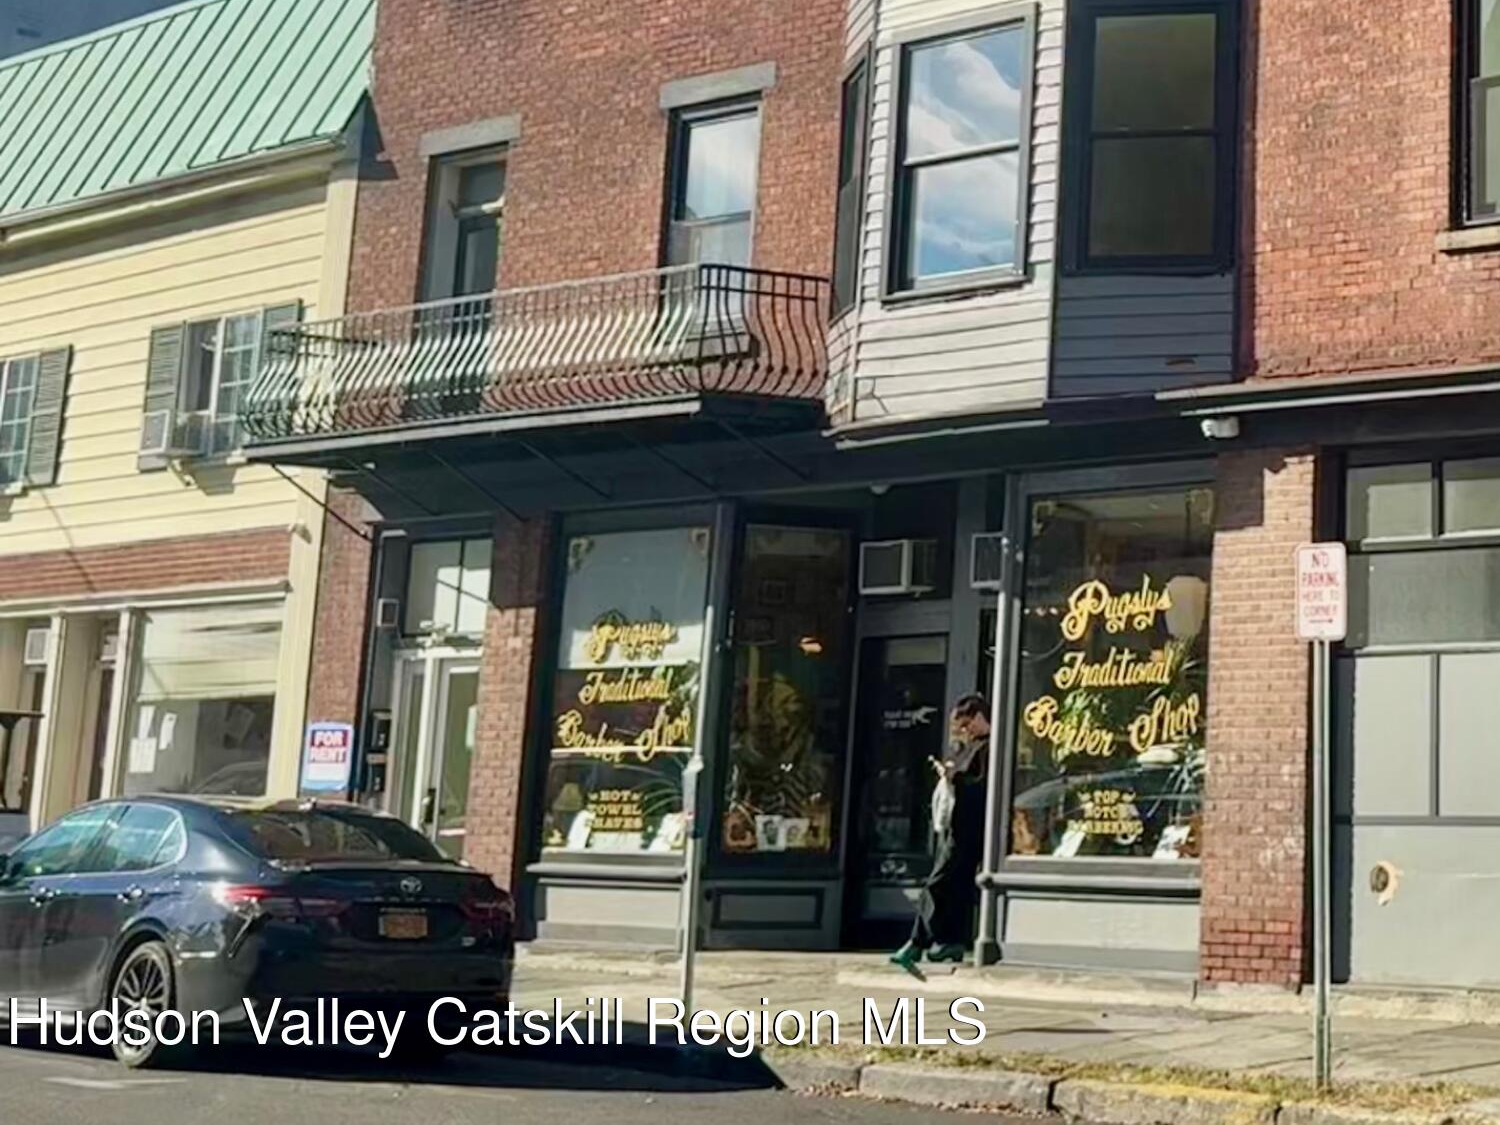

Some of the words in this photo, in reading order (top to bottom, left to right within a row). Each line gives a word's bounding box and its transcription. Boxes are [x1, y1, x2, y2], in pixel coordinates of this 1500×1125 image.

[1311, 551, 1329, 568] NO
[1302, 572, 1339, 587] PARKING
[1061, 574, 1172, 642] Pugslys
[1054, 646, 1175, 689] Traditional
[578, 668, 674, 705] Traditional
[1024, 695, 1117, 757] Barber
[1129, 692, 1200, 752] Shop
[315, 730, 344, 747] FOR
[310, 746, 347, 763] RENT
[599, 790, 632, 801] HOT
[1093, 790, 1120, 805] TOP
